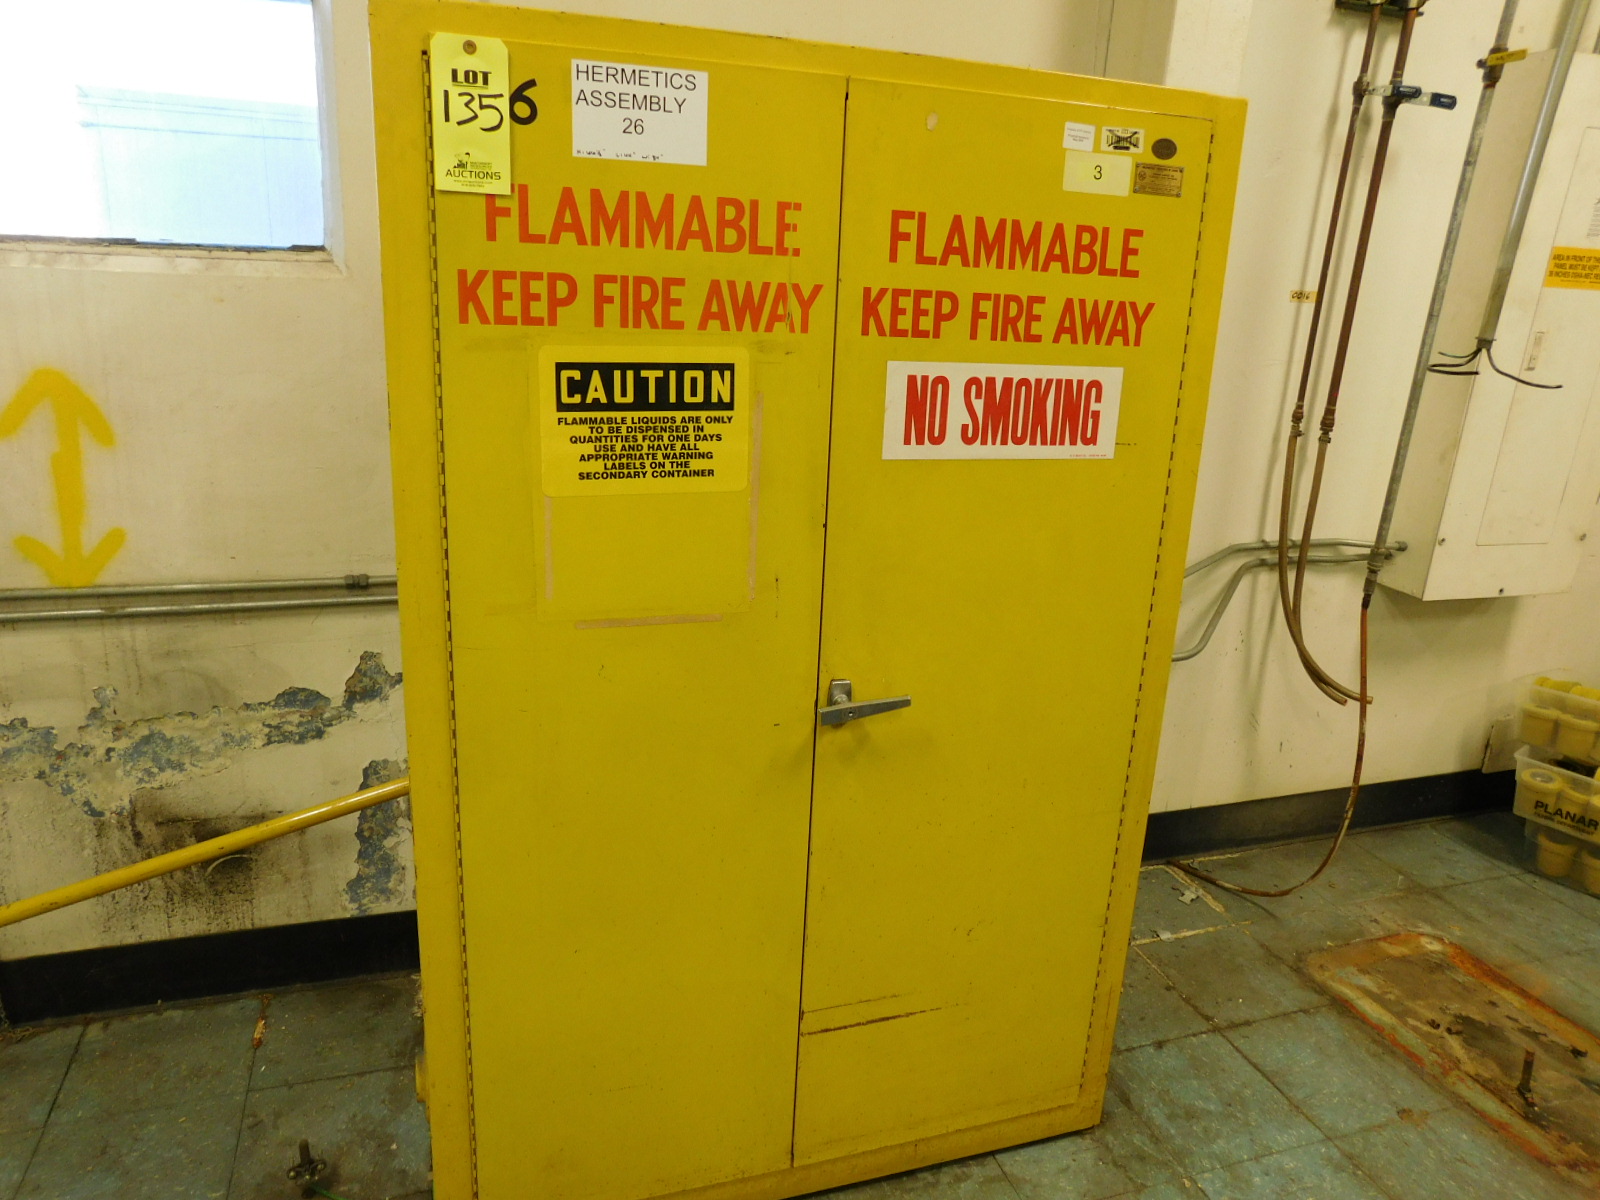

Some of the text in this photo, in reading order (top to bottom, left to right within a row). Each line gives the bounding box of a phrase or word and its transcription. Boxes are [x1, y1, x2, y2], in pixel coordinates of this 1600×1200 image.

[451, 68, 492, 87] LOT
[575, 63, 697, 92] HERMETICS
[575, 89, 687, 114] ASSEMBLY
[622, 117, 645, 135] 26
[445, 169, 501, 181] AUCTIONS
[1093, 164, 1103, 181] 3
[485, 183, 802, 258] FLAMMABLE
[889, 209, 1144, 279] FLAMMABLE
[456, 268, 824, 334] KEEP FIRE AWAY
[861, 286, 1156, 347] KEEP FIRE AWAY
[560, 369, 731, 404] CAUTION
[903, 374, 1103, 447] NO SMOKING
[557, 415, 733, 426] FLAMMABLE LIQUIDS ARE ONLY
[589, 425, 704, 434] TO BE DISPENSED IN
[569, 434, 722, 444] QUANTITIES FOR ONE DAYS
[594, 443, 700, 453] USE AND HAVE ALL
[579, 451, 713, 462] APPROPRIATE WARNING
[604, 460, 690, 471] LABELS ON THE
[578, 469, 715, 480] SECONDARY CONTAINER
[1534, 800, 1600, 831] PLANAR
